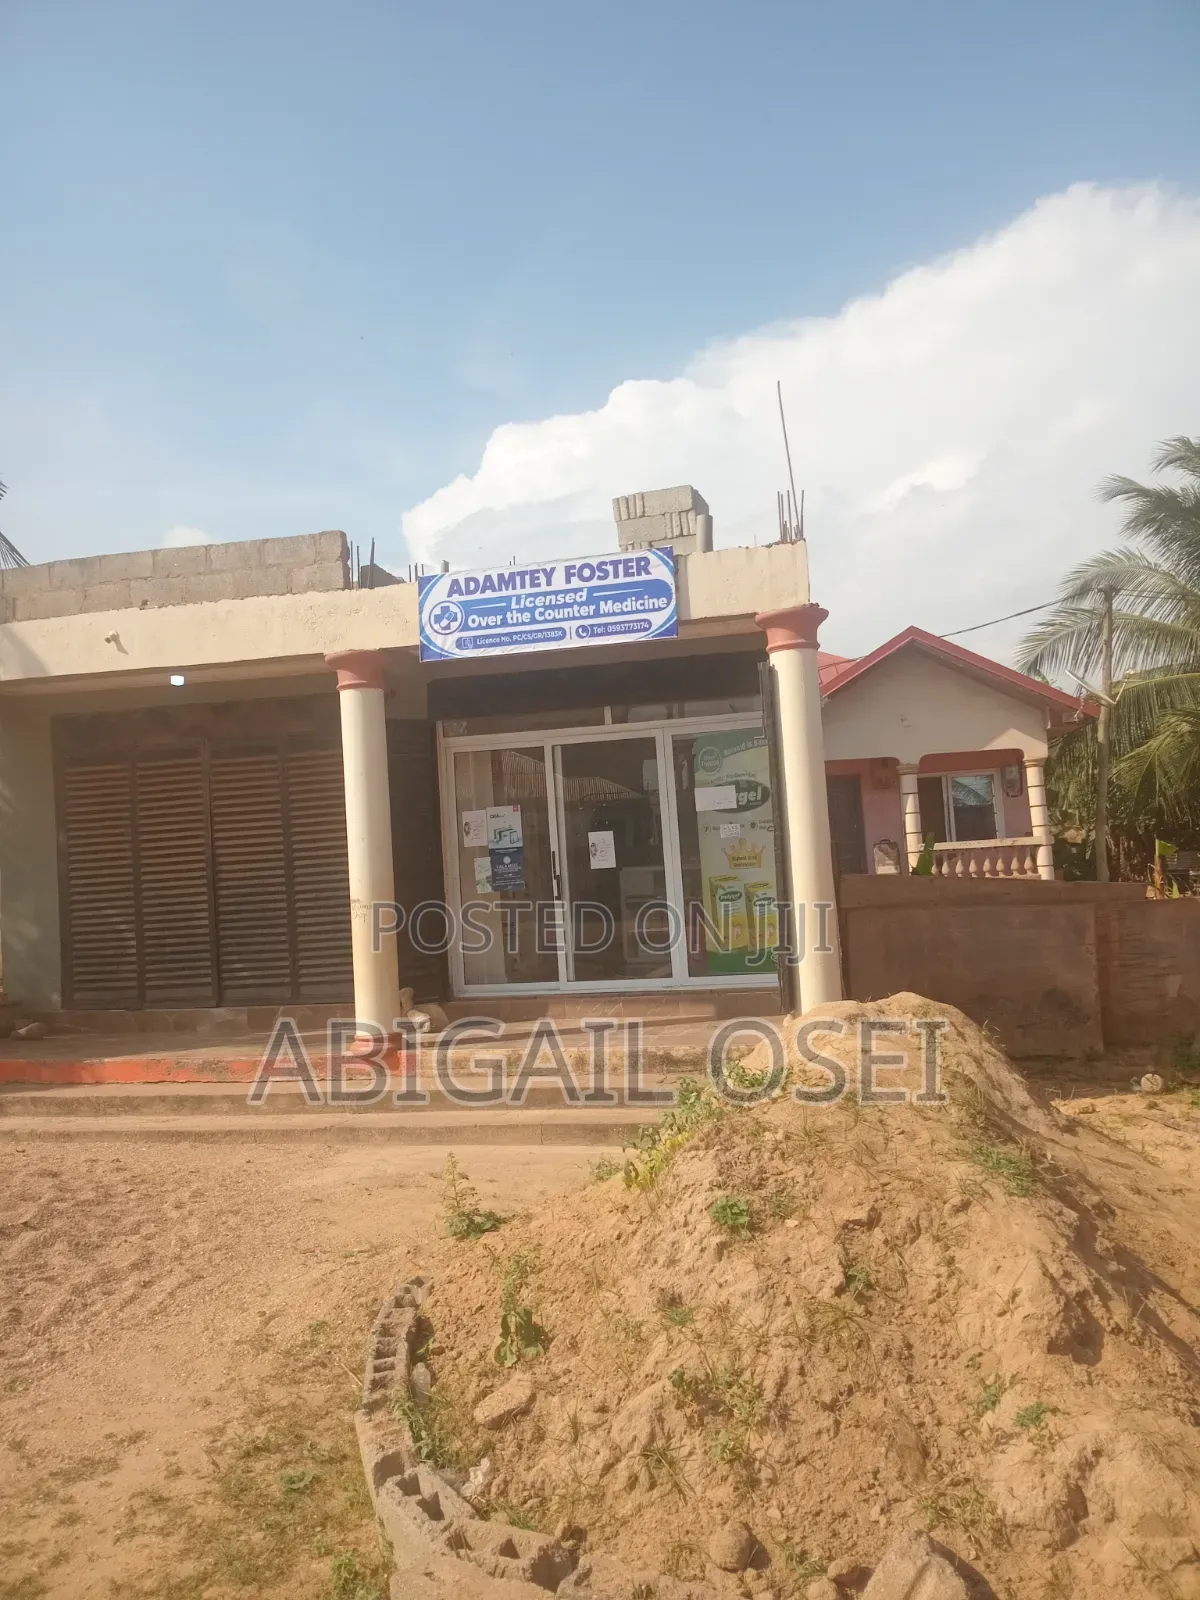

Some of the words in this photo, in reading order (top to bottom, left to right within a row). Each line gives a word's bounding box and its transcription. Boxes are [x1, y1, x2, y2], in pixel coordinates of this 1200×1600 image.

[447, 567, 556, 598] ADAMTEY
[564, 556, 652, 585] FOSTER
[511, 588, 588, 609] Licensed
[468, 614, 503, 628] Over
[506, 610, 531, 624] the
[534, 604, 596, 621] Counter
[600, 595, 667, 614] Medicine
[593, 626, 606, 634] Tel:
[607, 622, 649, 633] 0593773174
[477, 637, 500, 645] Licence
